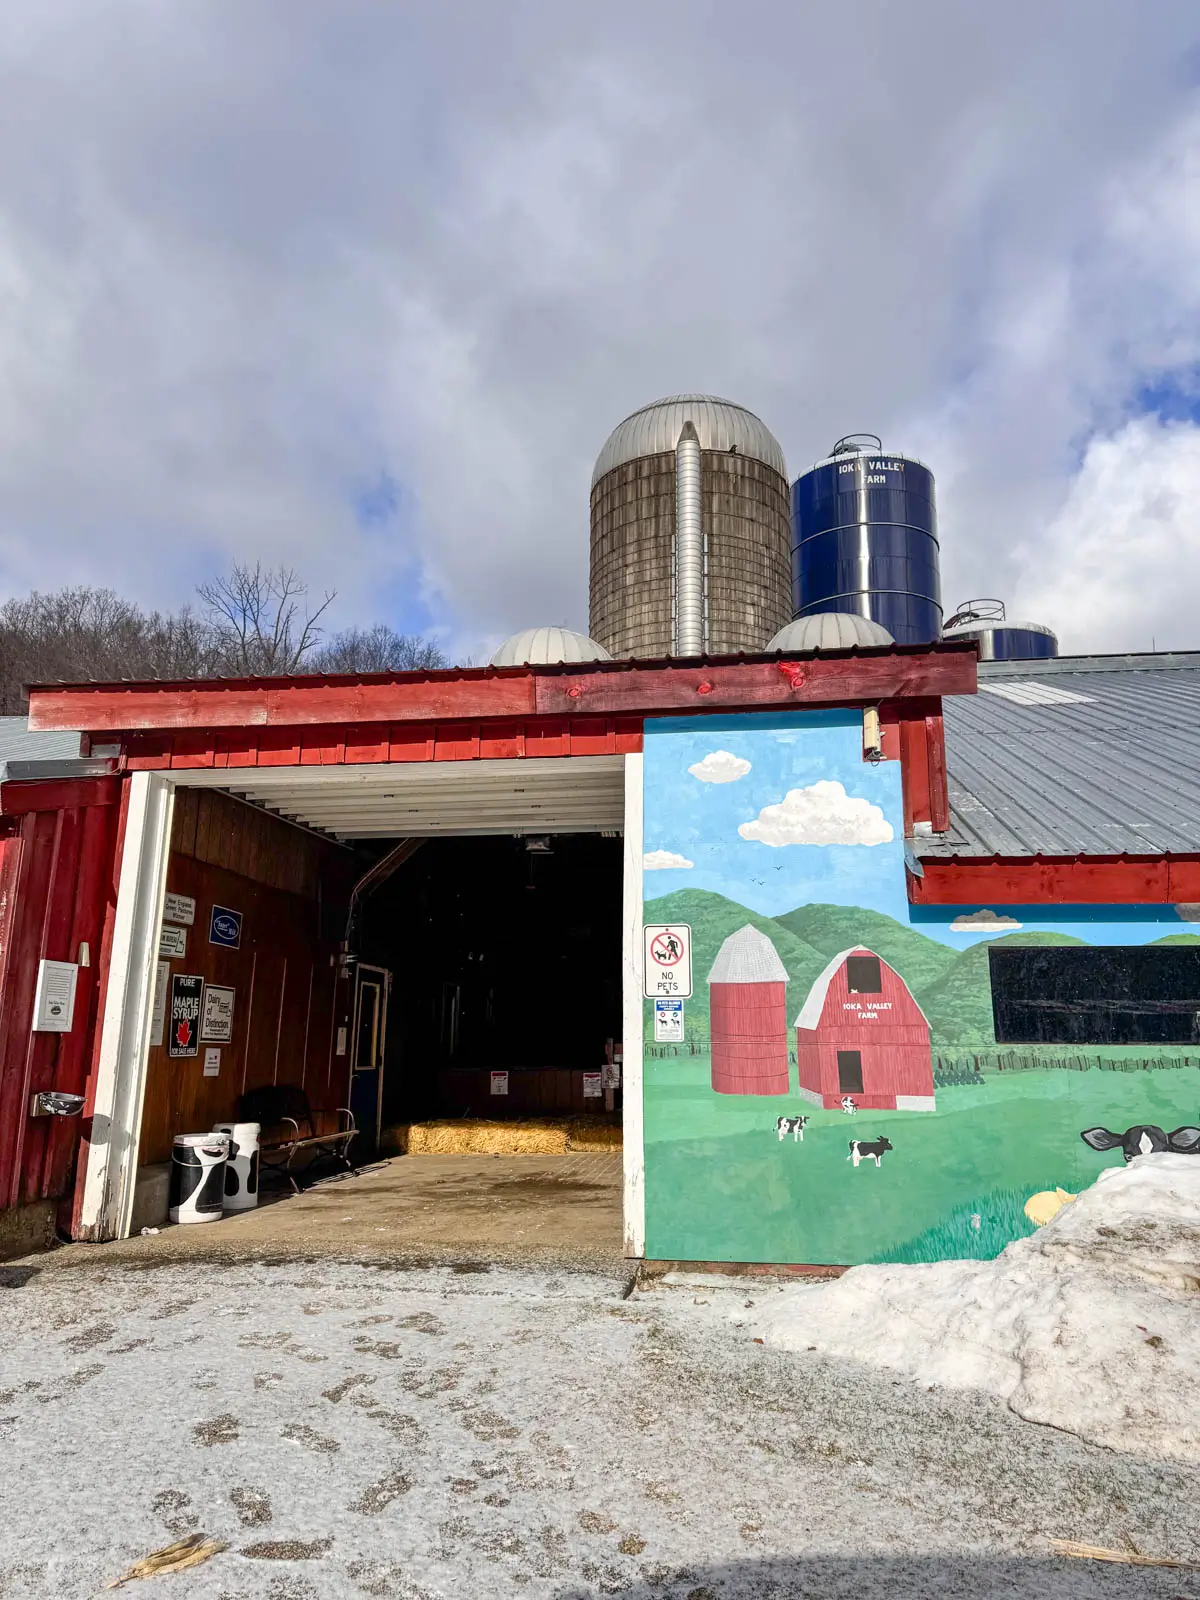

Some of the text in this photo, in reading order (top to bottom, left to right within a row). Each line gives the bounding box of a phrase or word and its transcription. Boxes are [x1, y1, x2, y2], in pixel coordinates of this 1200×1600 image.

[839, 461, 904, 474] IOKA VALLEY
[862, 475, 886, 484] FARM
[662, 971, 673, 980] NO
[180, 978, 196, 987] PURE
[657, 982, 678, 991] PETS
[174, 996, 199, 1009] MAPLE
[208, 994, 220, 1006] Dairy
[207, 1006, 213, 1015] of
[867, 1002, 892, 1010] VALLEY
[173, 1007, 198, 1020] SYRUP
[206, 1018, 229, 1028] Distinction
